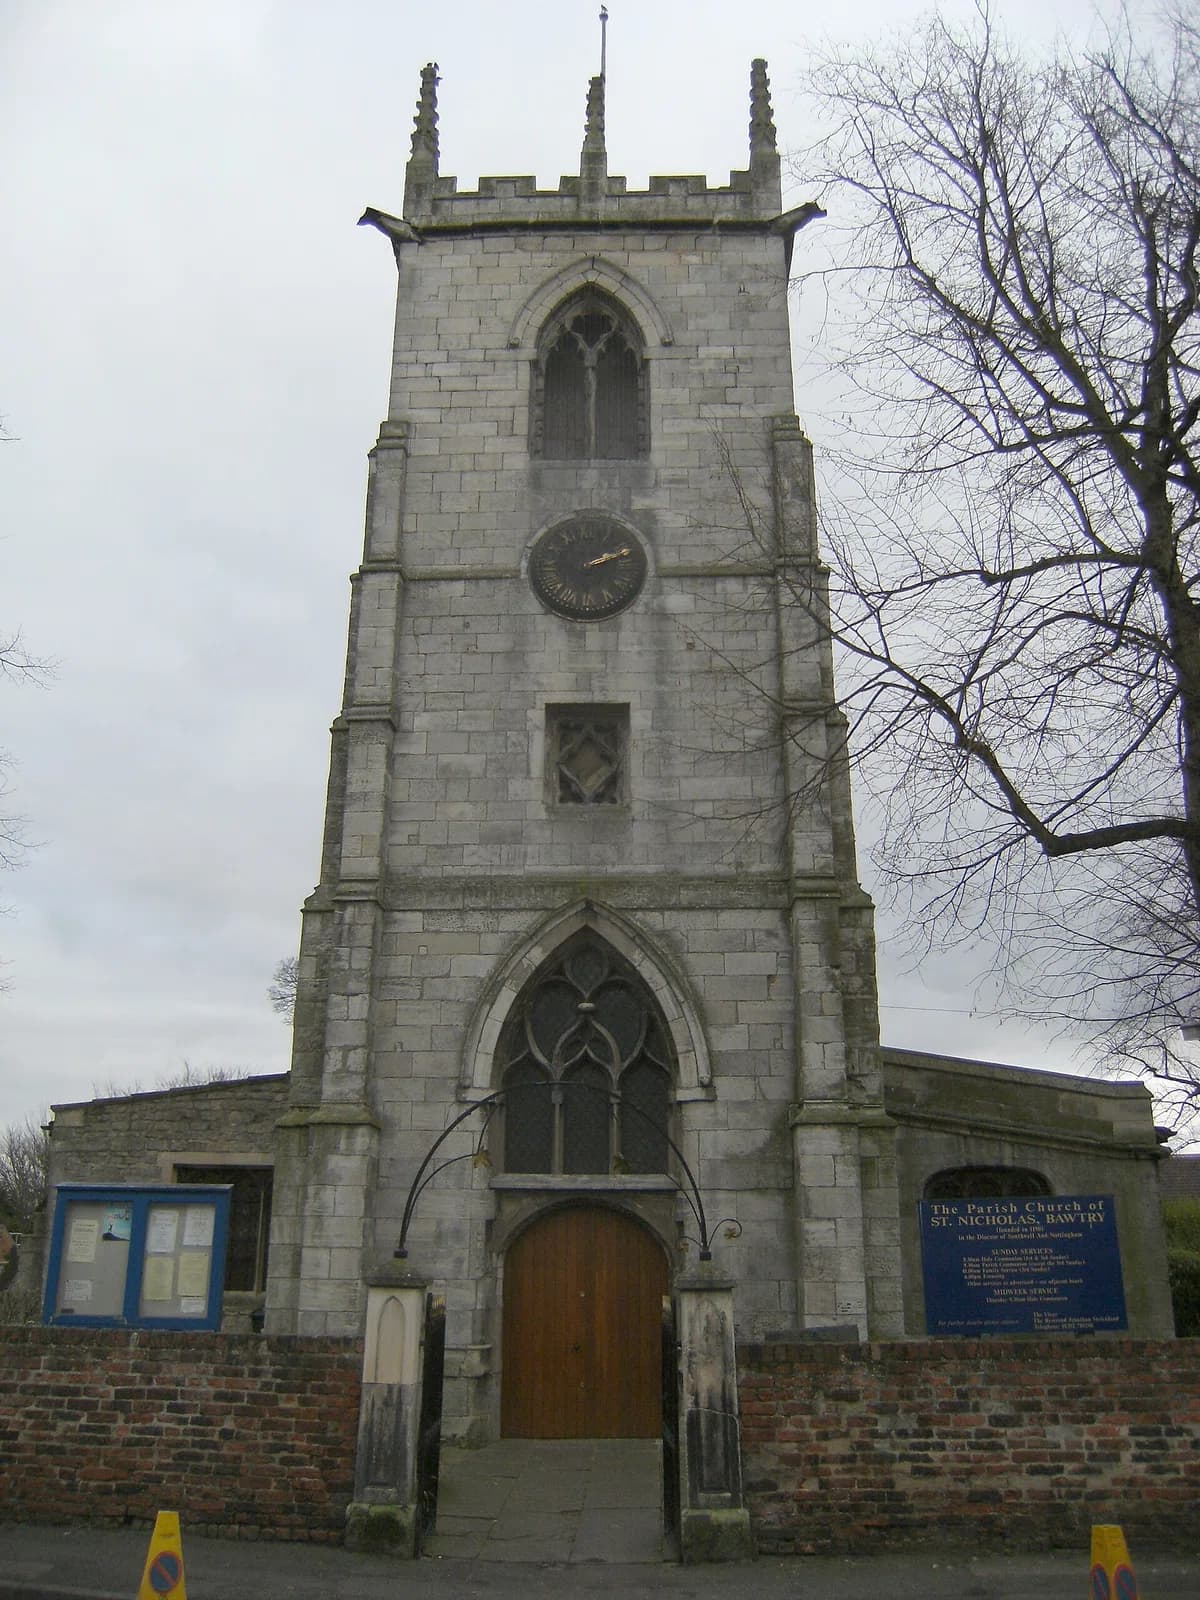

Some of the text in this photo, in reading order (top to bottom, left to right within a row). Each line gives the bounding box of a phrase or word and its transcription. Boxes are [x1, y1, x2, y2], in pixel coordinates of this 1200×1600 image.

[930, 1200, 1104, 1215] The Parish Church of
[930, 1212, 1105, 1228] ST. NICHOLAS, BAWTRY
